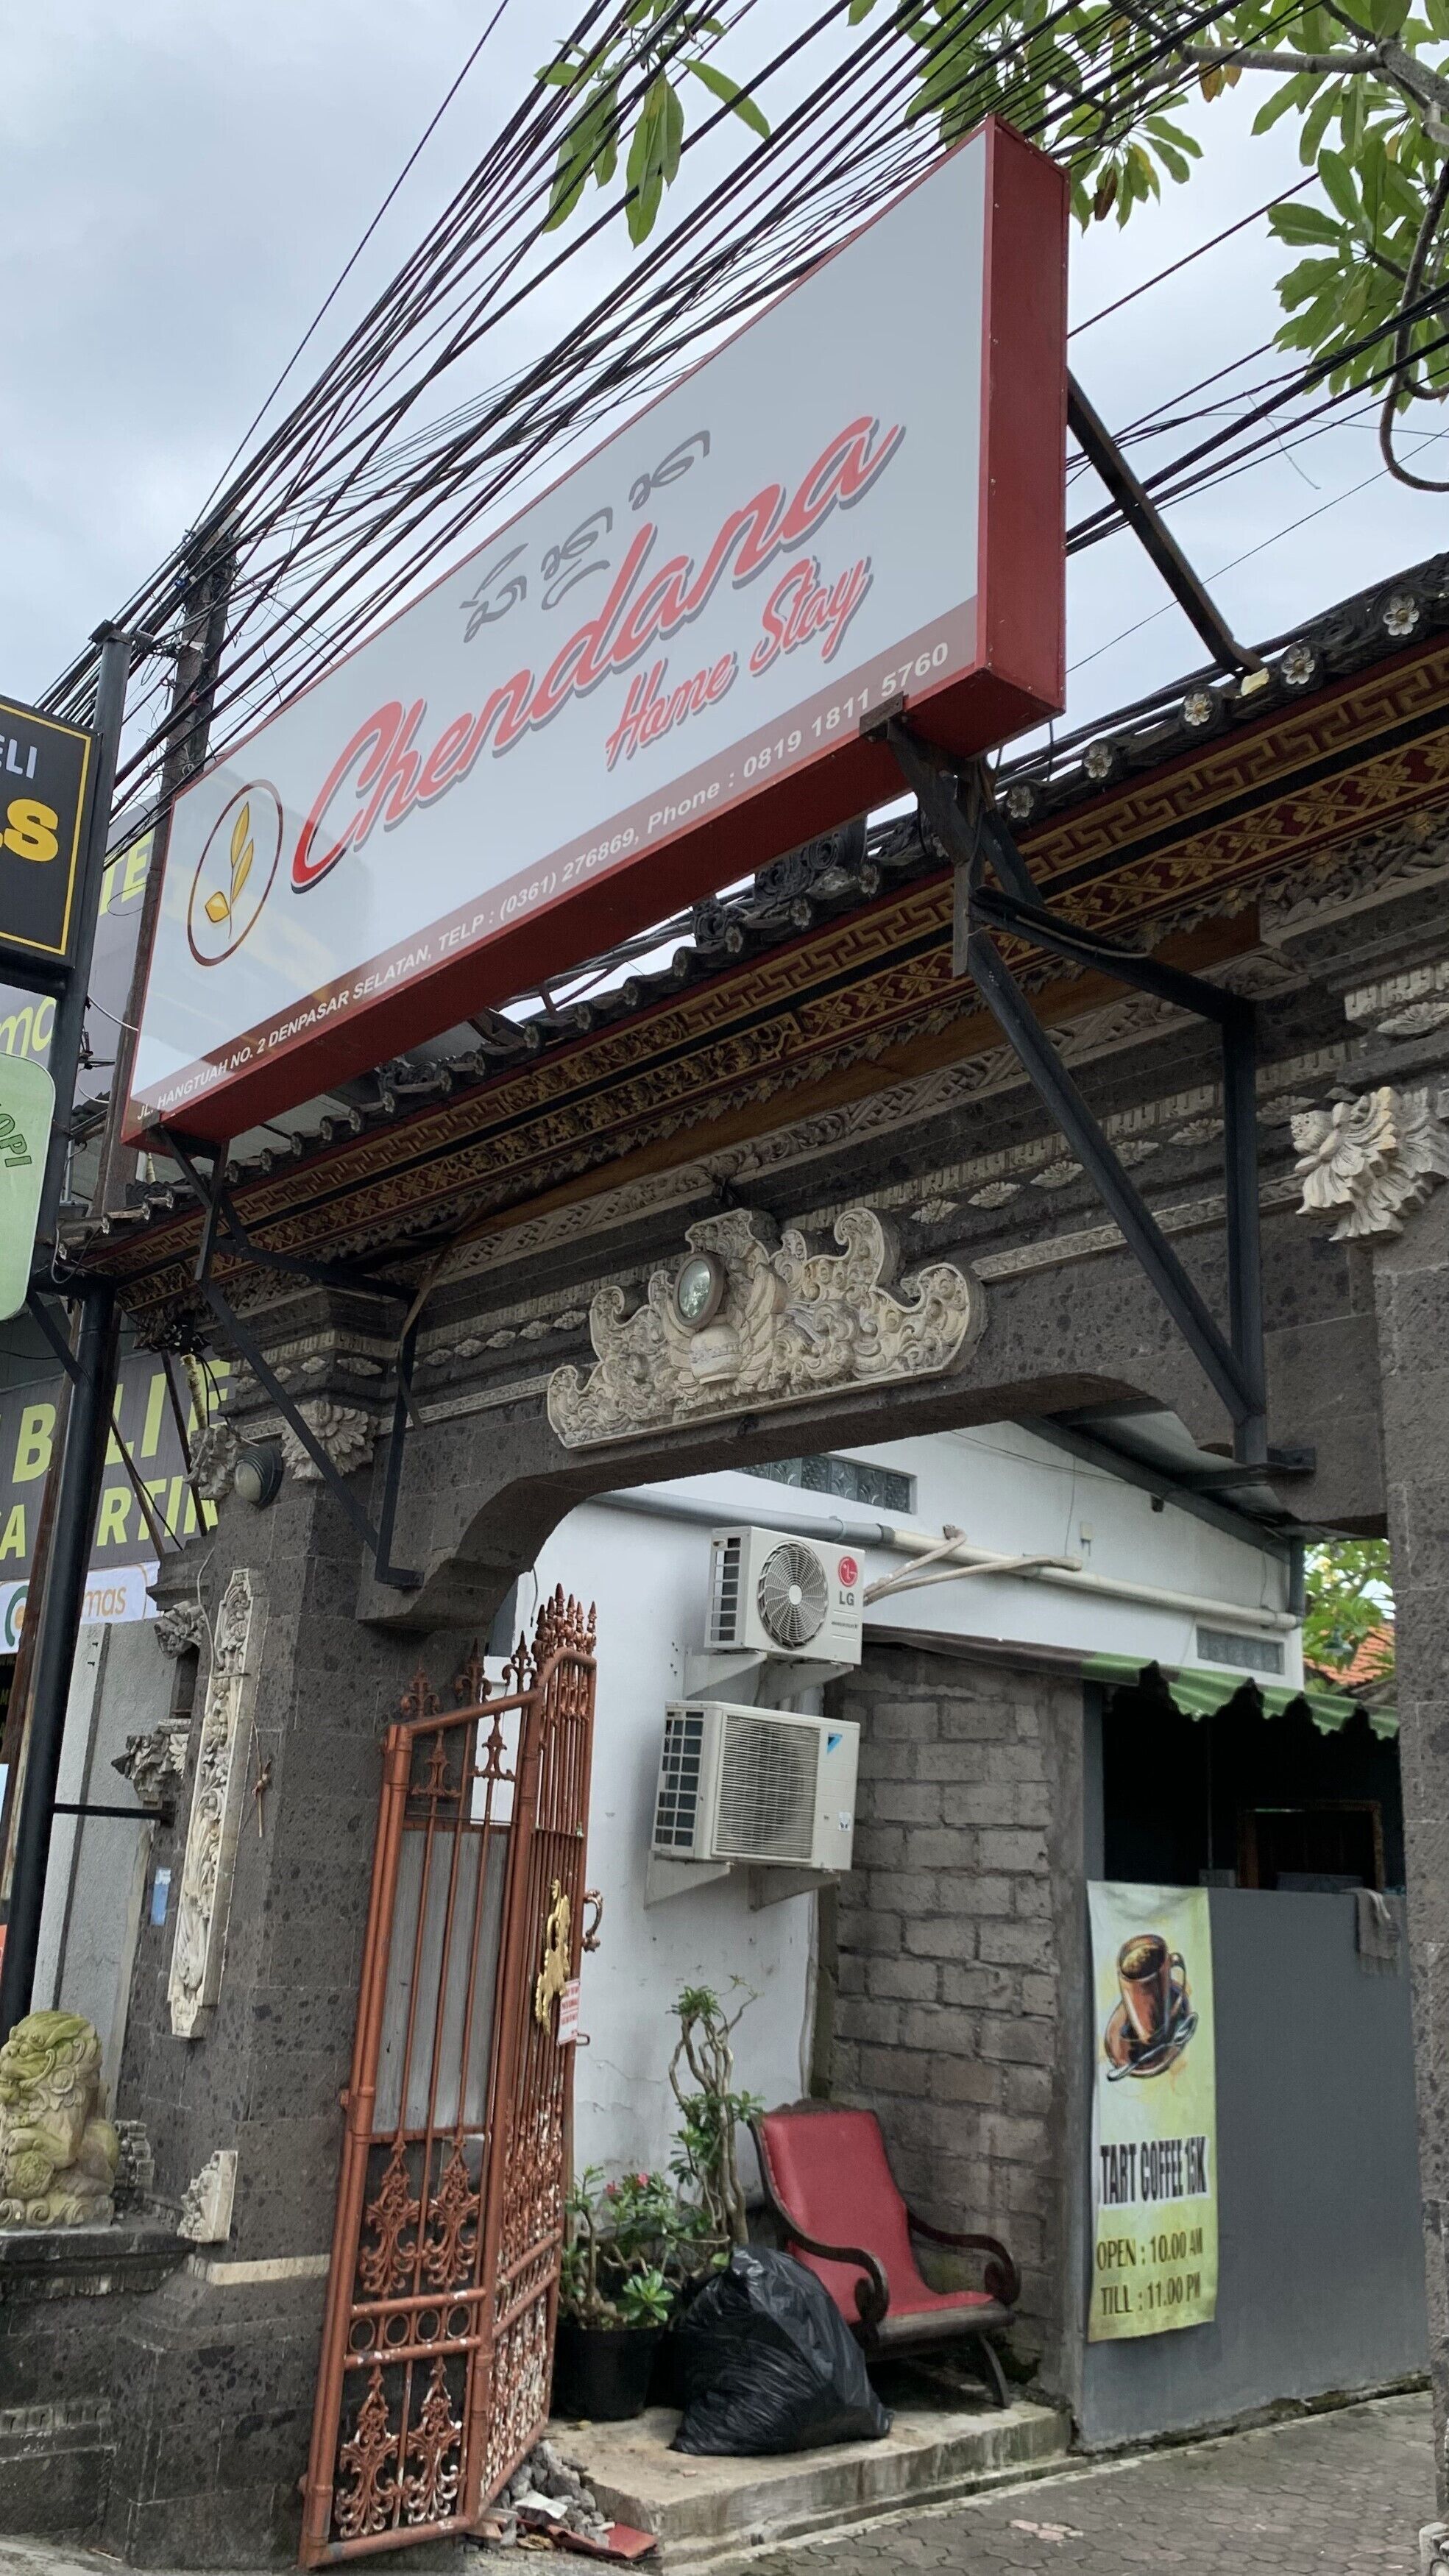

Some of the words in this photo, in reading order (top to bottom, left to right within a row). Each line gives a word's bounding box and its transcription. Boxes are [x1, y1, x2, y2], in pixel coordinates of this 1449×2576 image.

[749, 555, 874, 678] Stay
[291, 415, 906, 894] Chendana
[0, 734, 38, 779] LI
[137, 1103, 155, 1120] JL.
[157, 1058, 229, 1110] HANGTUAH
[230, 1048, 254, 1070] NO.
[256, 1037, 268, 1055] 2
[267, 988, 350, 1049] DENPASAR
[352, 944, 433, 1001] SELATAN,
[439, 913, 485, 952] TELP
[500, 872, 558, 921] (0361)
[562, 828, 640, 882] 276869,
[647, 780, 720, 834] Phone
[743, 729, 802, 779] 0819
[811, 687, 870, 737] 1811
[880, 642, 949, 698] 5760
[839, 1590, 854, 1605] LG
[1141, 2138, 1183, 2201] COFFEE
[1097, 2237, 1136, 2271] OPEN
[1149, 2231, 1187, 2264] 10.00
[1189, 2226, 1203, 2256] AM
[1100, 2284, 1133, 2316] TILL
[1147, 2276, 1183, 2310] 11.00
